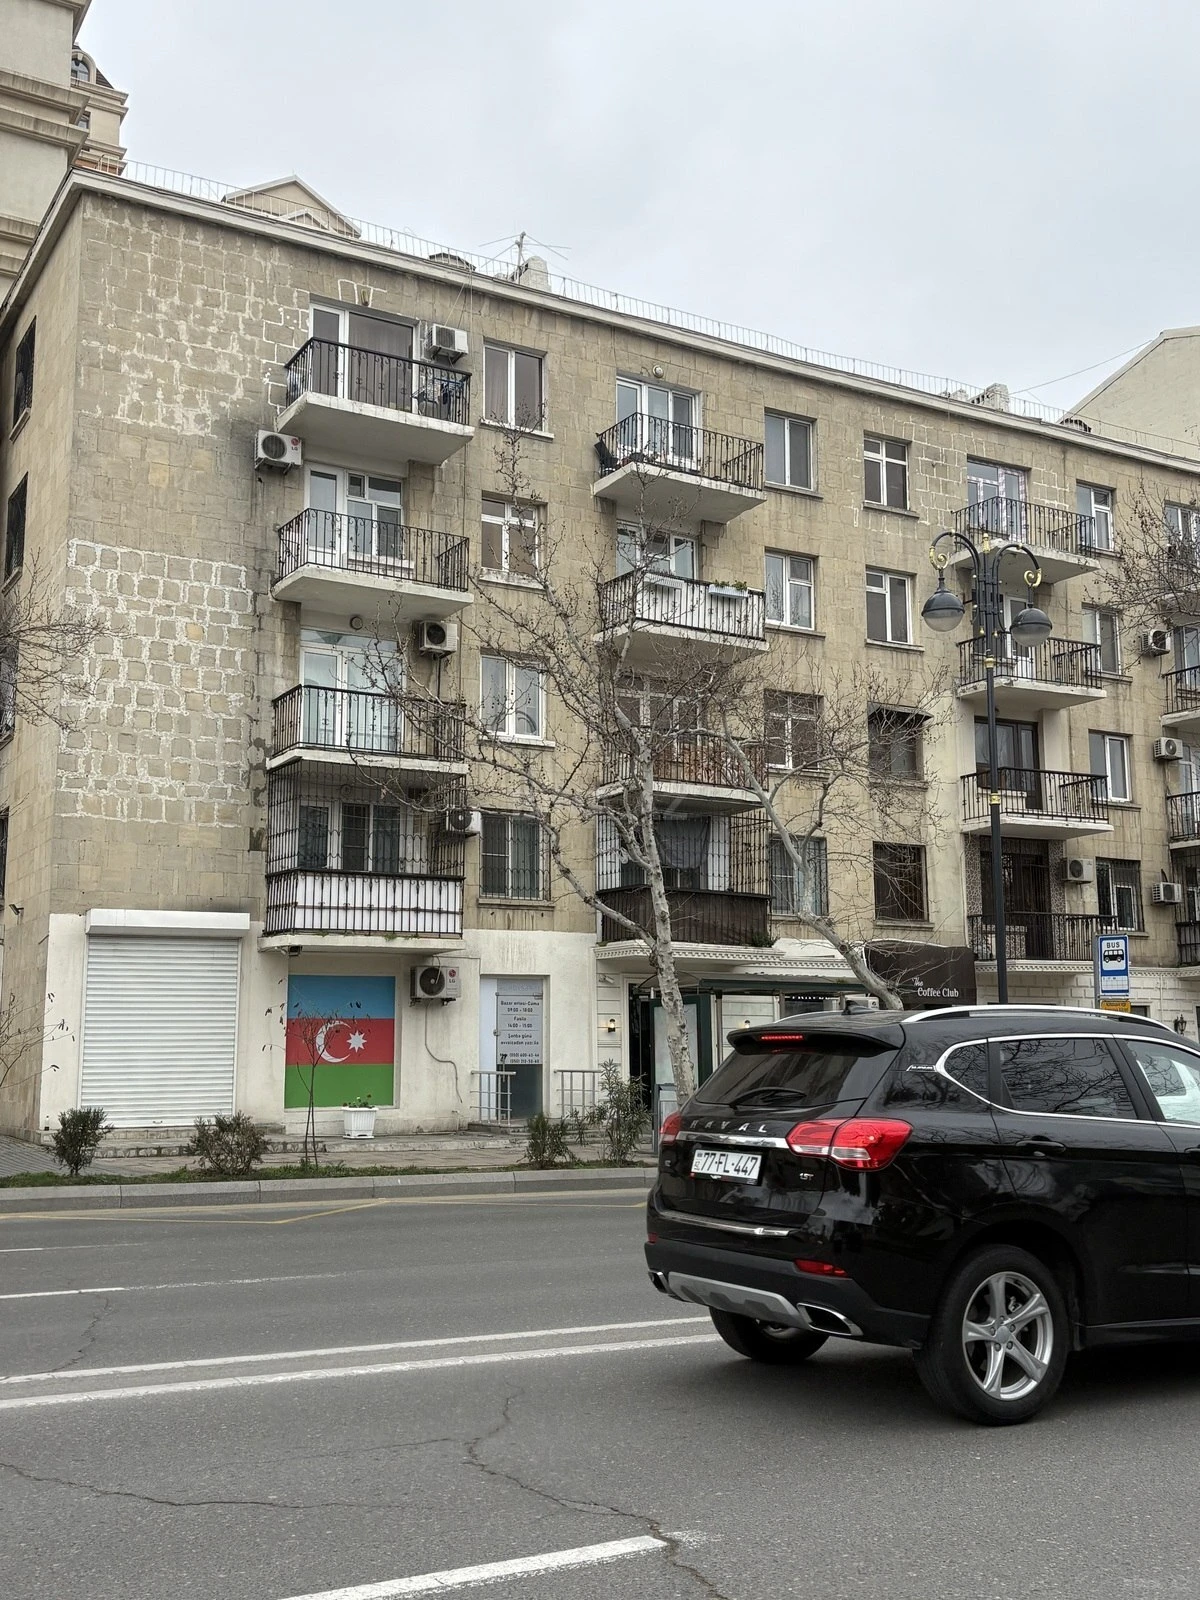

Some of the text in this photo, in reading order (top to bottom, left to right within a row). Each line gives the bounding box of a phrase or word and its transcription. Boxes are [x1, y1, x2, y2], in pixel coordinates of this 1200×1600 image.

[912, 977, 924, 986] The
[917, 987, 959, 998] Coffee Club
[690, 1120, 767, 1133] HAVAL
[700, 1152, 759, 1176] 77-FL-447
